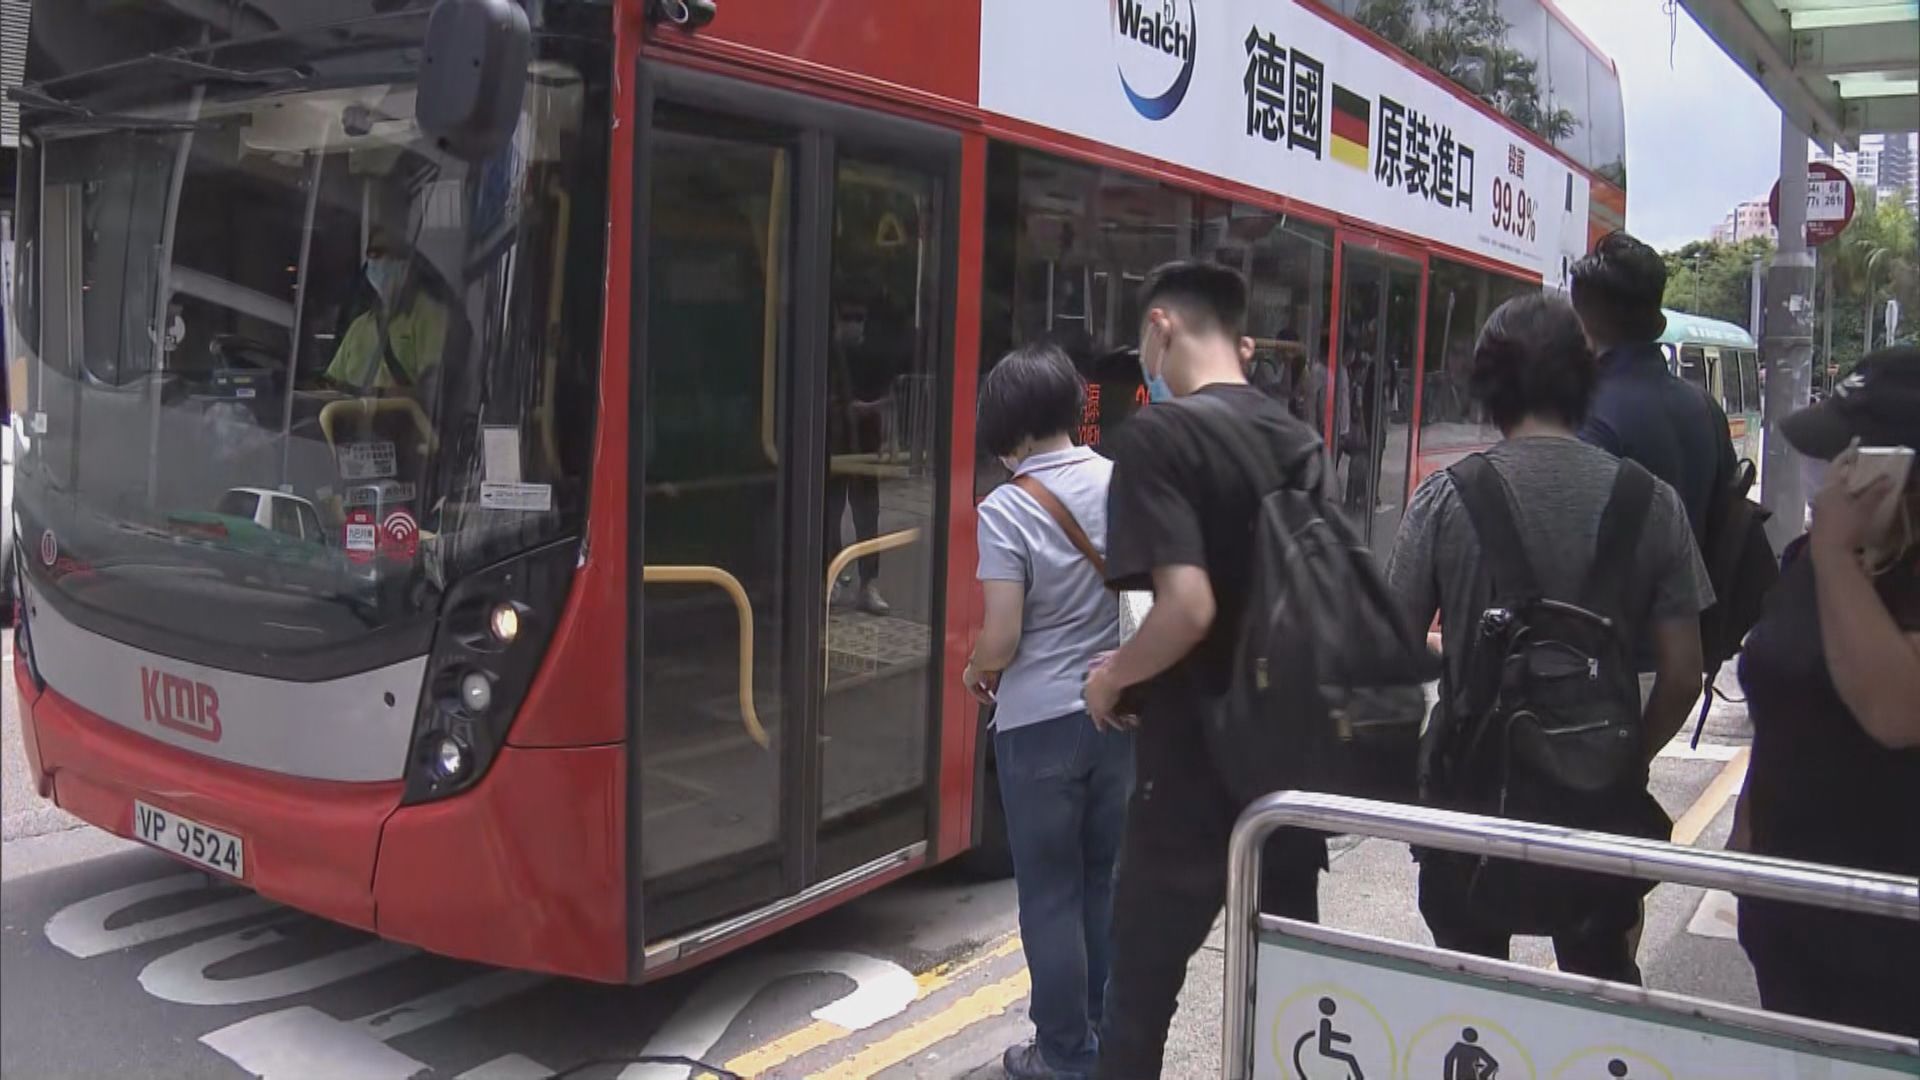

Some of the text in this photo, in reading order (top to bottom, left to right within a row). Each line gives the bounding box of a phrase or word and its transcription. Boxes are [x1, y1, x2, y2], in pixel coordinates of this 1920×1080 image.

[1117, 0, 1188, 62] Walch
[1243, 24, 1475, 213] 德國 原裝進口
[1492, 176, 1537, 243] 99.9%
[140, 666, 223, 743] KMB
[140, 806, 239, 872] VP 9524
